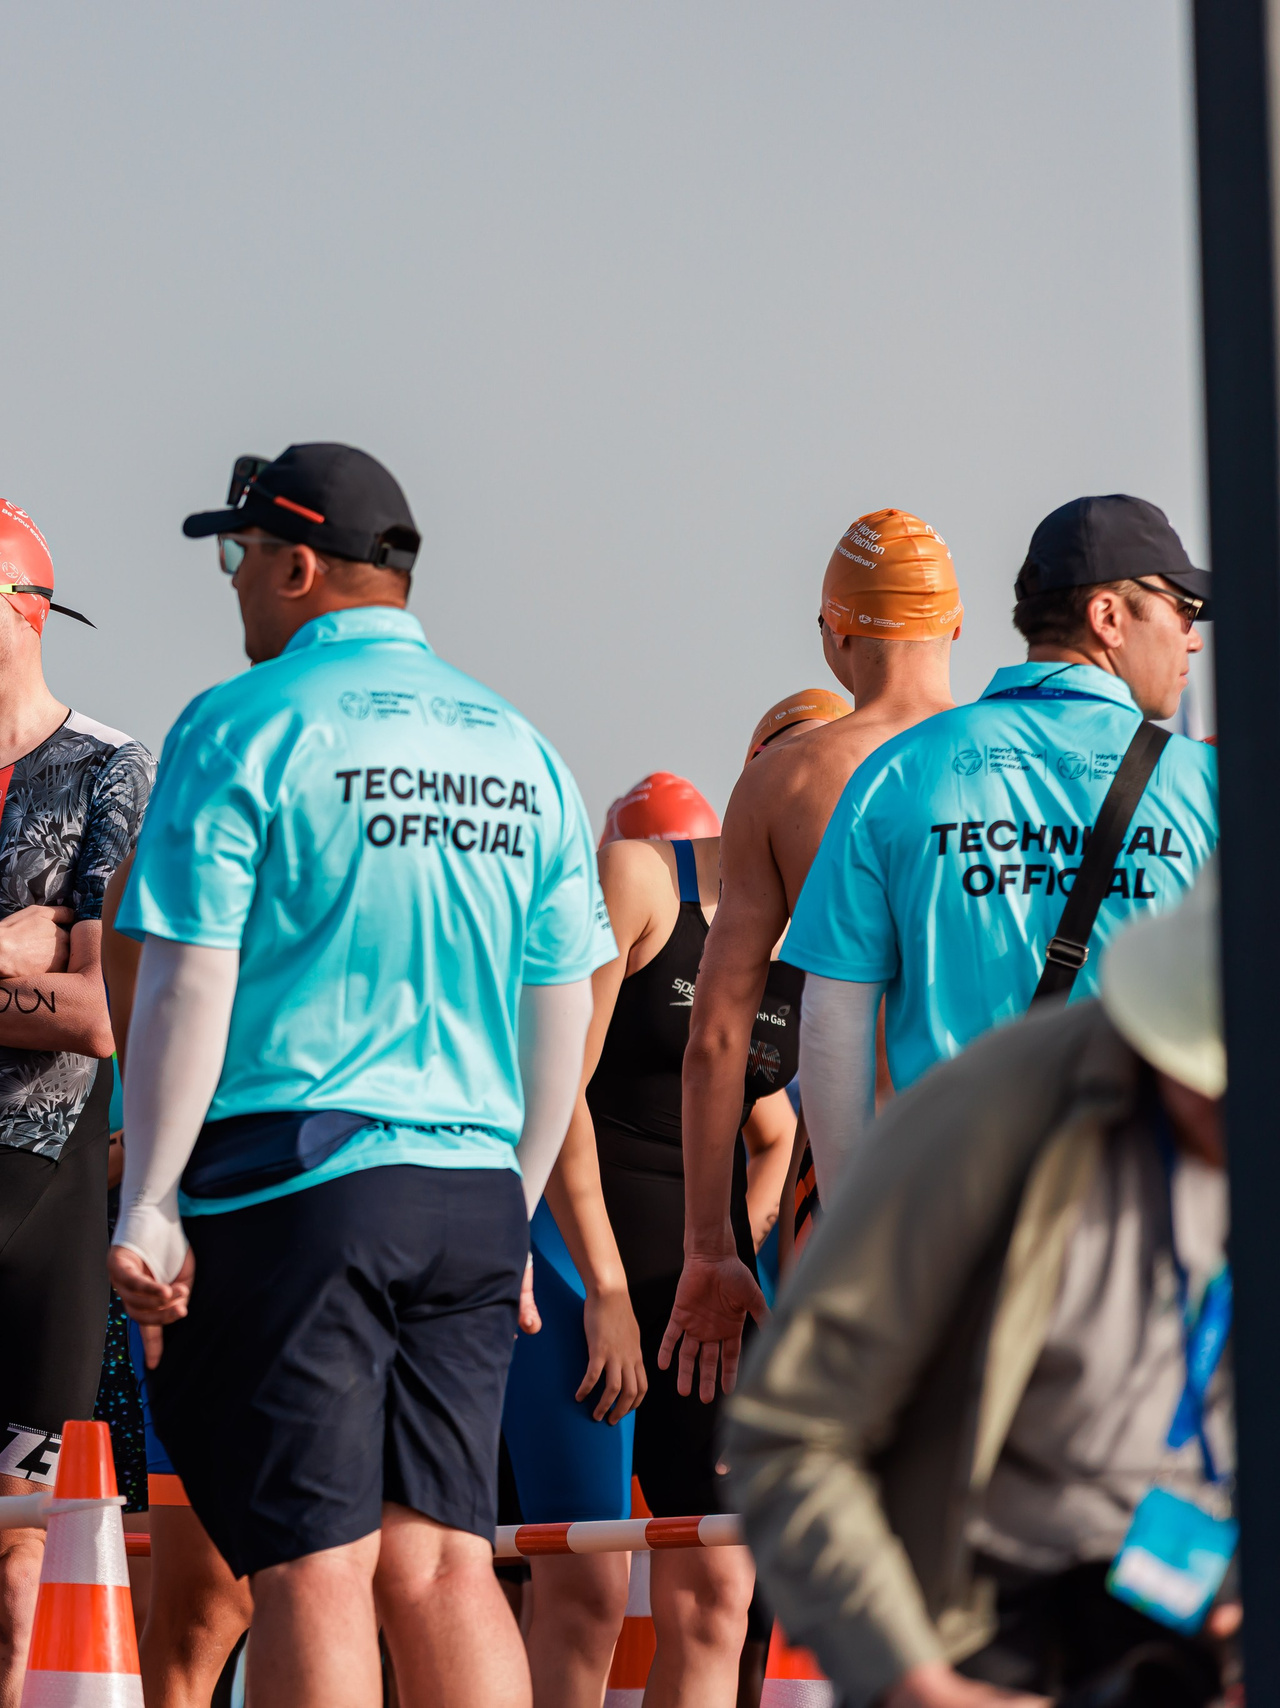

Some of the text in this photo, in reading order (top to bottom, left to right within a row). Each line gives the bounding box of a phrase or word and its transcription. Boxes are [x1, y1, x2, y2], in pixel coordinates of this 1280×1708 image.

[850, 531, 885, 555] Triathlon
[1007, 754, 1021, 762] Cup
[1094, 760, 1109, 768] Cup
[1095, 753, 1118, 761] World
[335, 767, 542, 816] TECHNICAL
[366, 814, 524, 858] OFFICIAL
[931, 820, 1182, 858] TECHNIAL
[671, 978, 695, 996] spe
[770, 1014, 786, 1027] Gas
